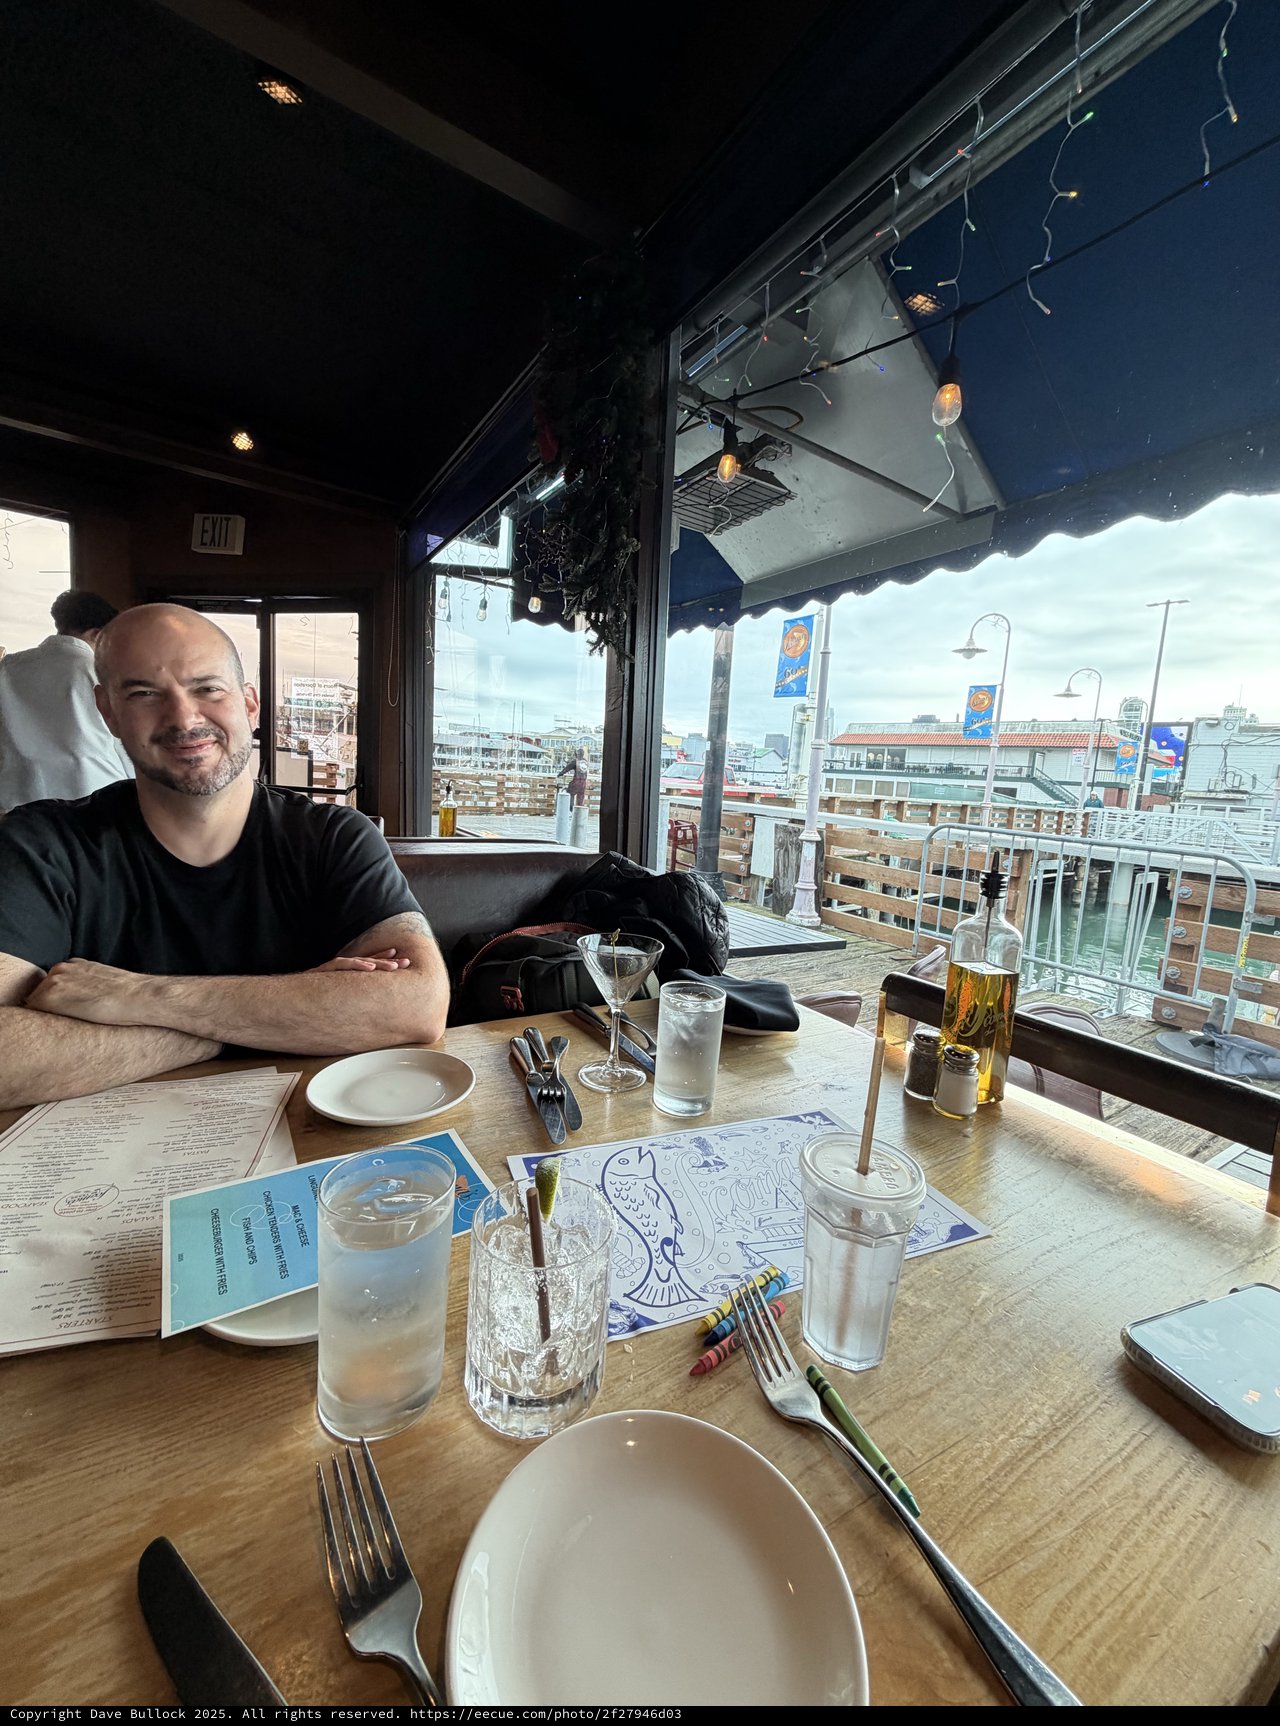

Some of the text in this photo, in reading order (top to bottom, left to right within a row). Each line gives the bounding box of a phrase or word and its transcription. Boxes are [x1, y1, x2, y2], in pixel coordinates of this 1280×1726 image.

[200, 516, 232, 547] EXIT
[210, 1208, 229, 1296] CHEESEBURGER WITH FRIES
[242, 1217, 258, 1265] FISH AND CHIPS
[263, 1190, 290, 1280] CHICKEN TENDERS WITH FRIES
[296, 1224, 310, 1248] CHEESE
[56, 1316, 113, 1330] STARTERS
